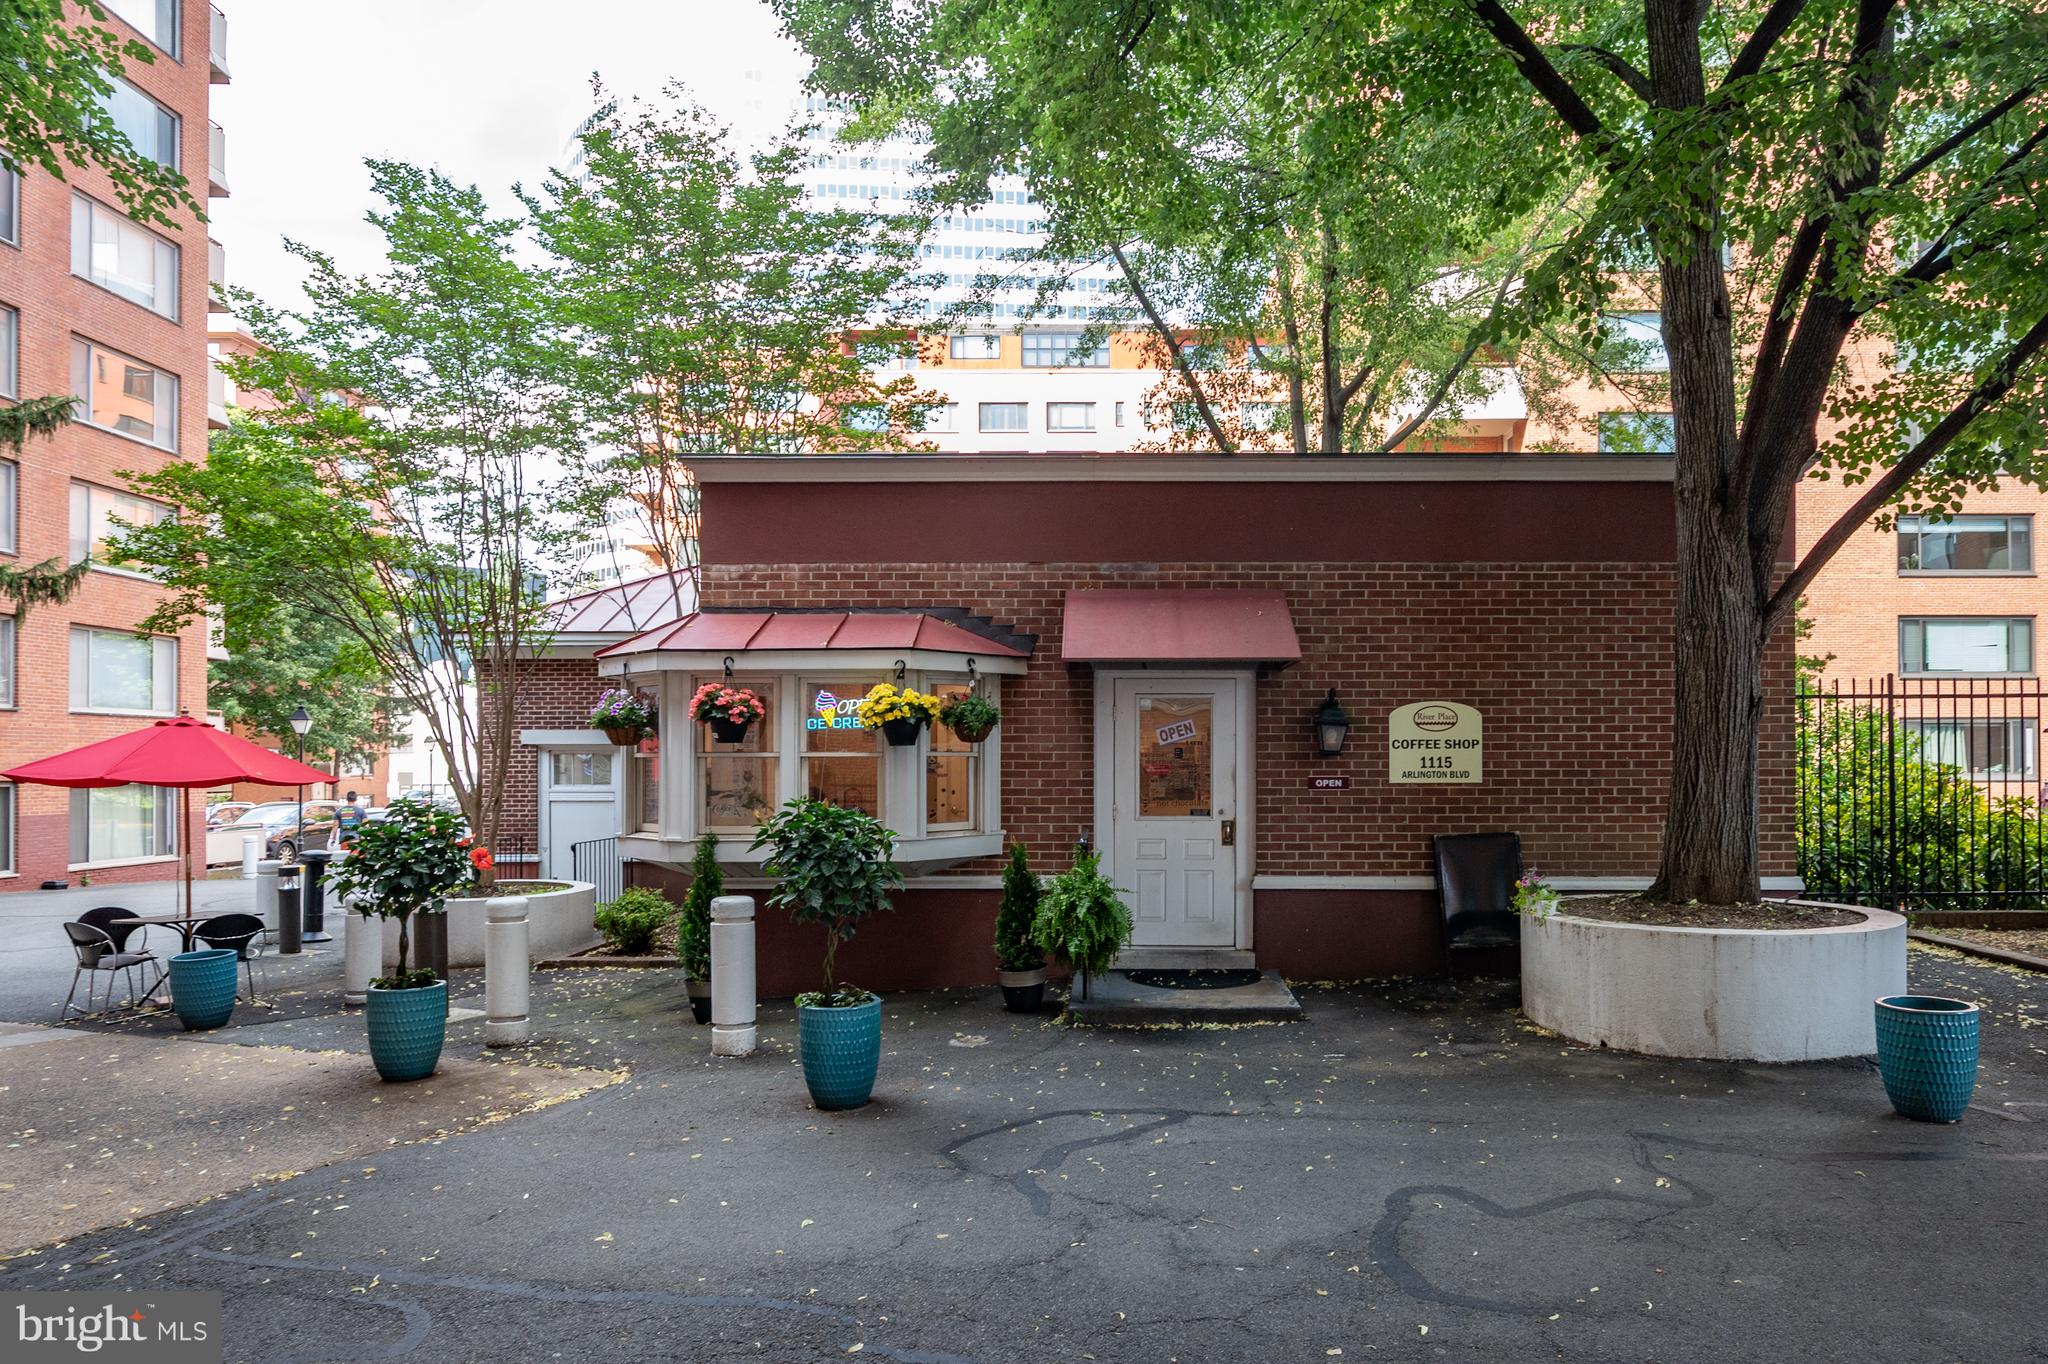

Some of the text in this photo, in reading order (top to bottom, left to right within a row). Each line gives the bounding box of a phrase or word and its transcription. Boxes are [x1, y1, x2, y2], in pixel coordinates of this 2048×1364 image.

[837, 699, 871, 715] OP
[1417, 712, 1456, 720] River Place
[832, 717, 864, 729] CRE
[1159, 721, 1194, 742] OPEN
[1391, 739, 1480, 749] COFFEE SHOP
[1420, 756, 1453, 769] 1115
[1401, 770, 1470, 779] ARLINGTON BLVD
[1315, 779, 1343, 787] OPEN
